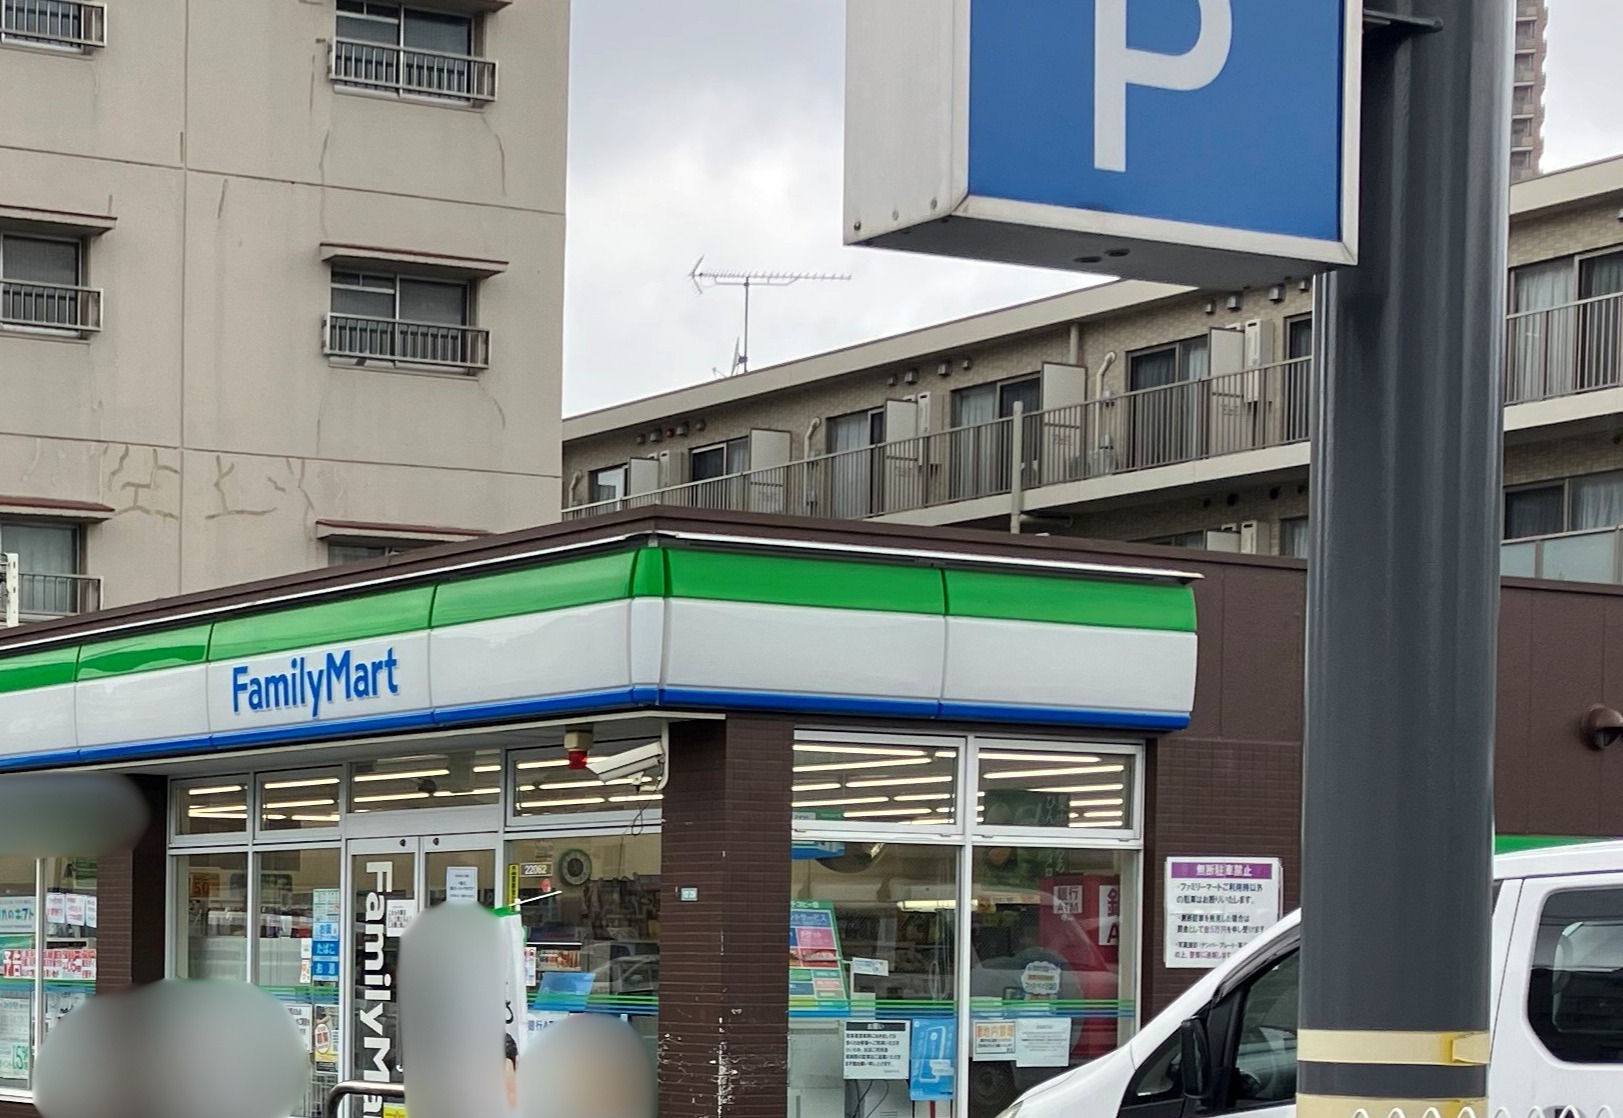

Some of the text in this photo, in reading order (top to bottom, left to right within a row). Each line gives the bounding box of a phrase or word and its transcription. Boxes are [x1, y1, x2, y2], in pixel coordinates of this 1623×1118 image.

[1093, 0, 1233, 173] P
[232, 647, 398, 718] FamilyMart
[316, 943, 336, 955] たばこ
